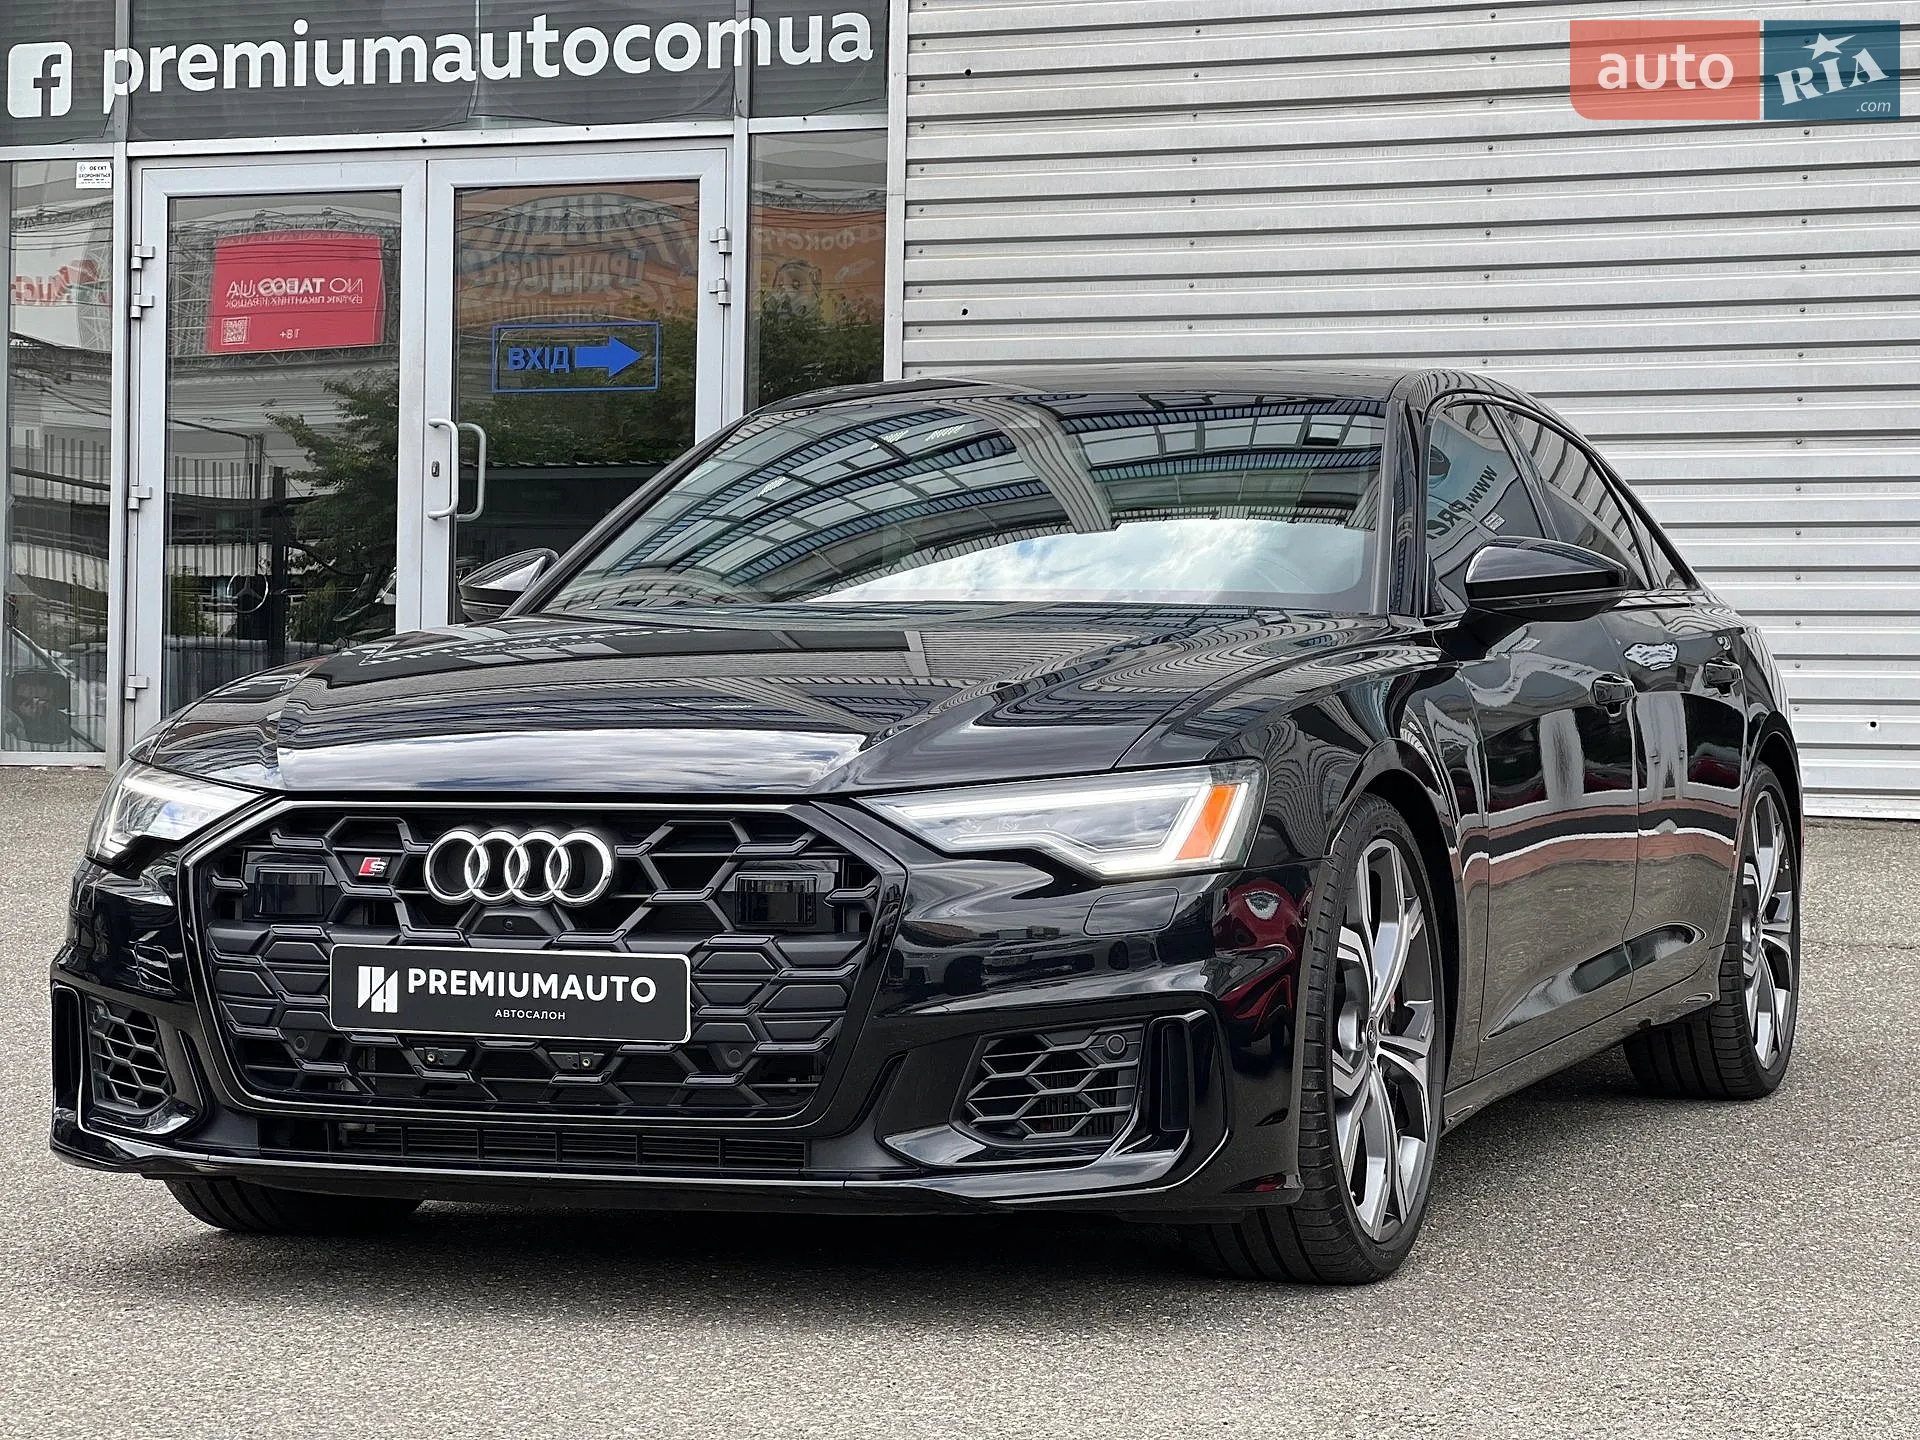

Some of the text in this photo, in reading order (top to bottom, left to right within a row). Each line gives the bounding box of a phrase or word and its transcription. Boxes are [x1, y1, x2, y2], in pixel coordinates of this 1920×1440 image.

[103, 10, 874, 115] premiumautocomua
[508, 346, 570, 374] ВХІД
[407, 967, 657, 1003] PREMIUMAUTO
[494, 1009, 567, 1021] АВТОСАЛОН
